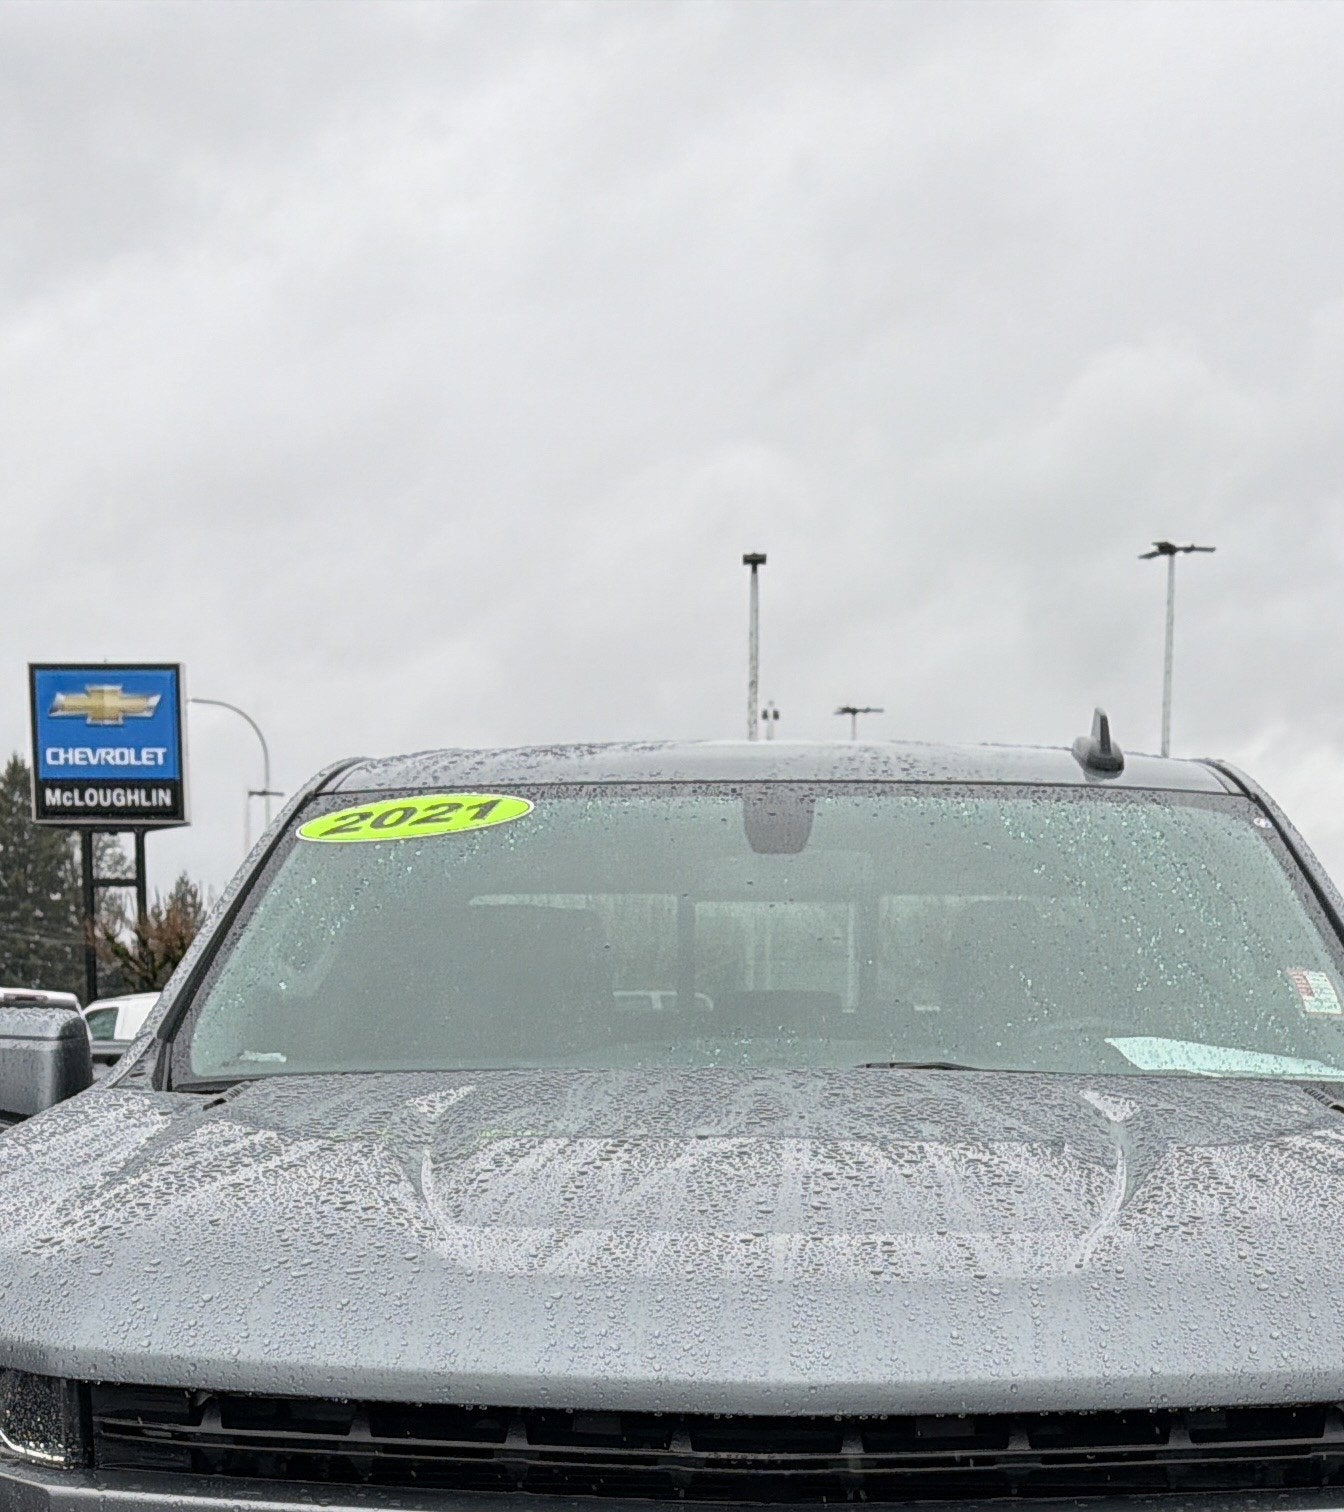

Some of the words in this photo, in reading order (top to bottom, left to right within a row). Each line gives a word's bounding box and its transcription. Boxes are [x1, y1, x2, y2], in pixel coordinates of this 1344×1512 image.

[45, 747, 167, 766] CHEVROLET
[45, 788, 172, 807] McLOUGHLIN
[319, 799, 503, 837] 2021
